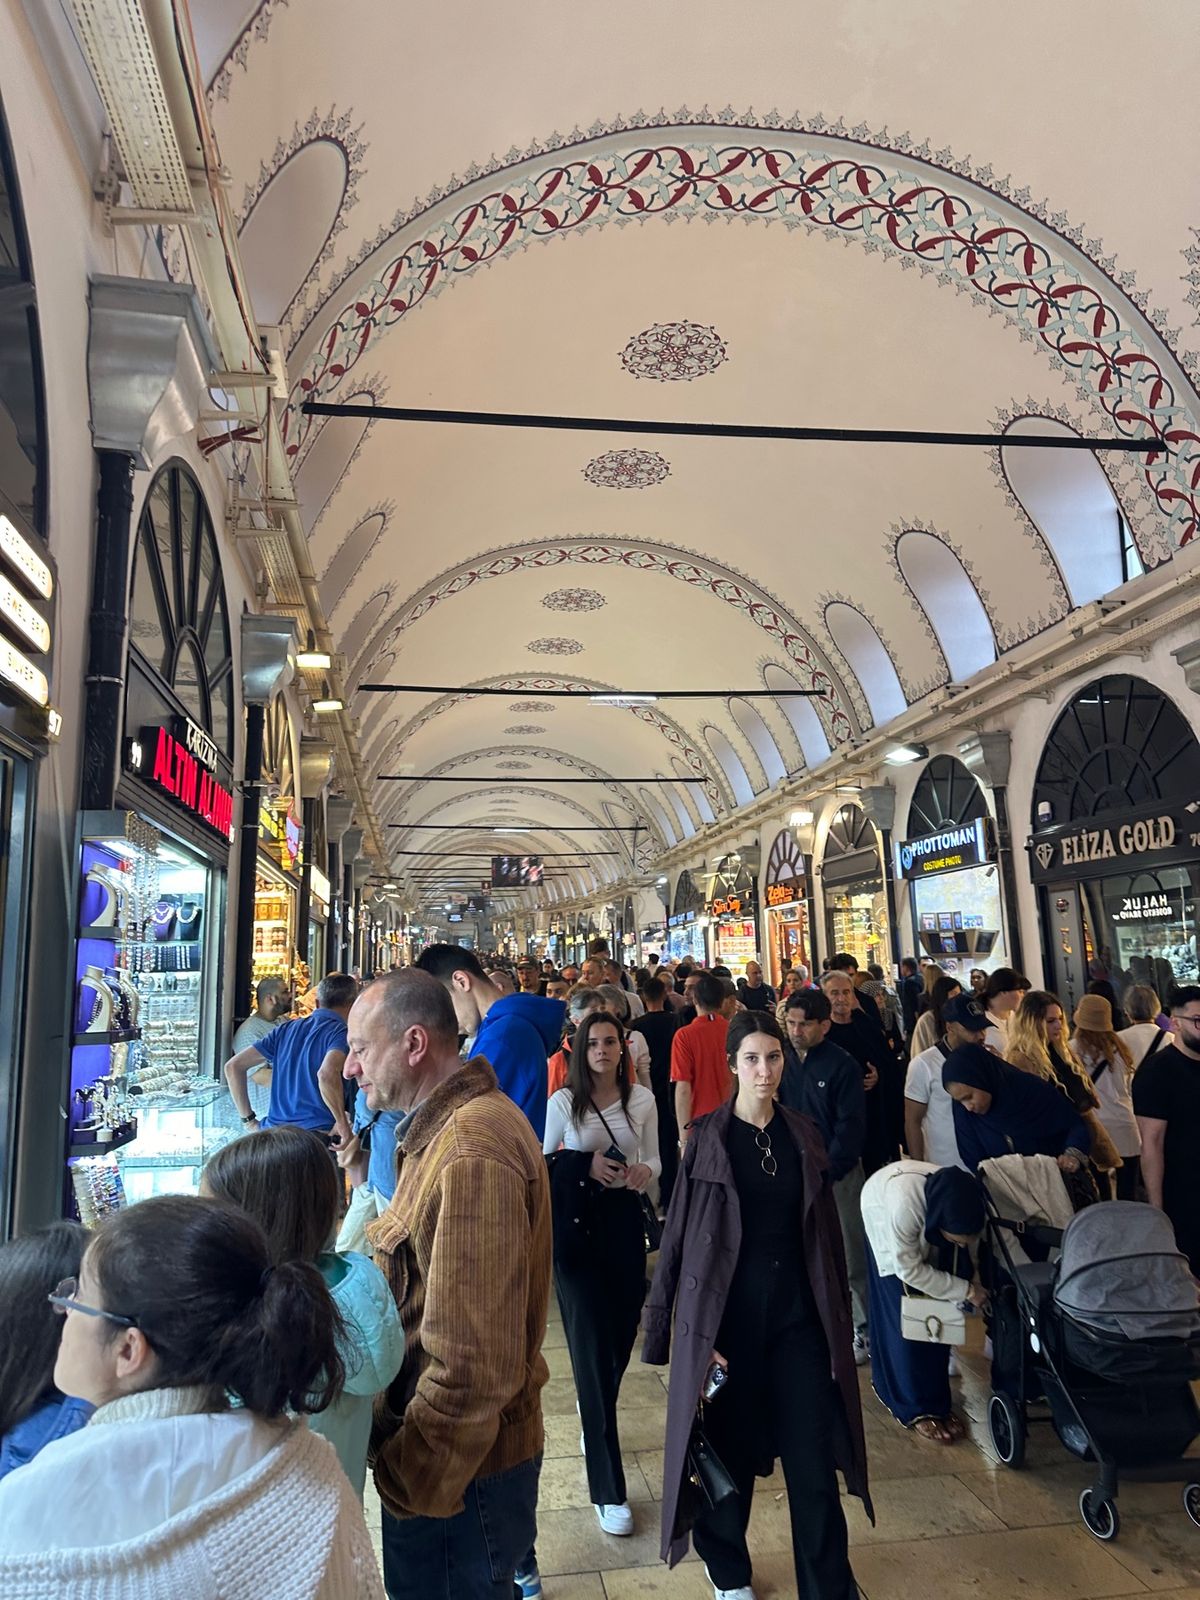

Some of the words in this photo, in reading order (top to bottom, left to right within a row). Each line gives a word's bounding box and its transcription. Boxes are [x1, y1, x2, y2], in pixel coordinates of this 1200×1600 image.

[48, 709, 62, 737] 97
[153, 725, 198, 810] ALTIN
[911, 826, 976, 857] PHOTTOMAN
[1060, 828, 1117, 866] ELİZA
[1118, 815, 1176, 855] GOLD
[945, 854, 963, 868] PHOTO
